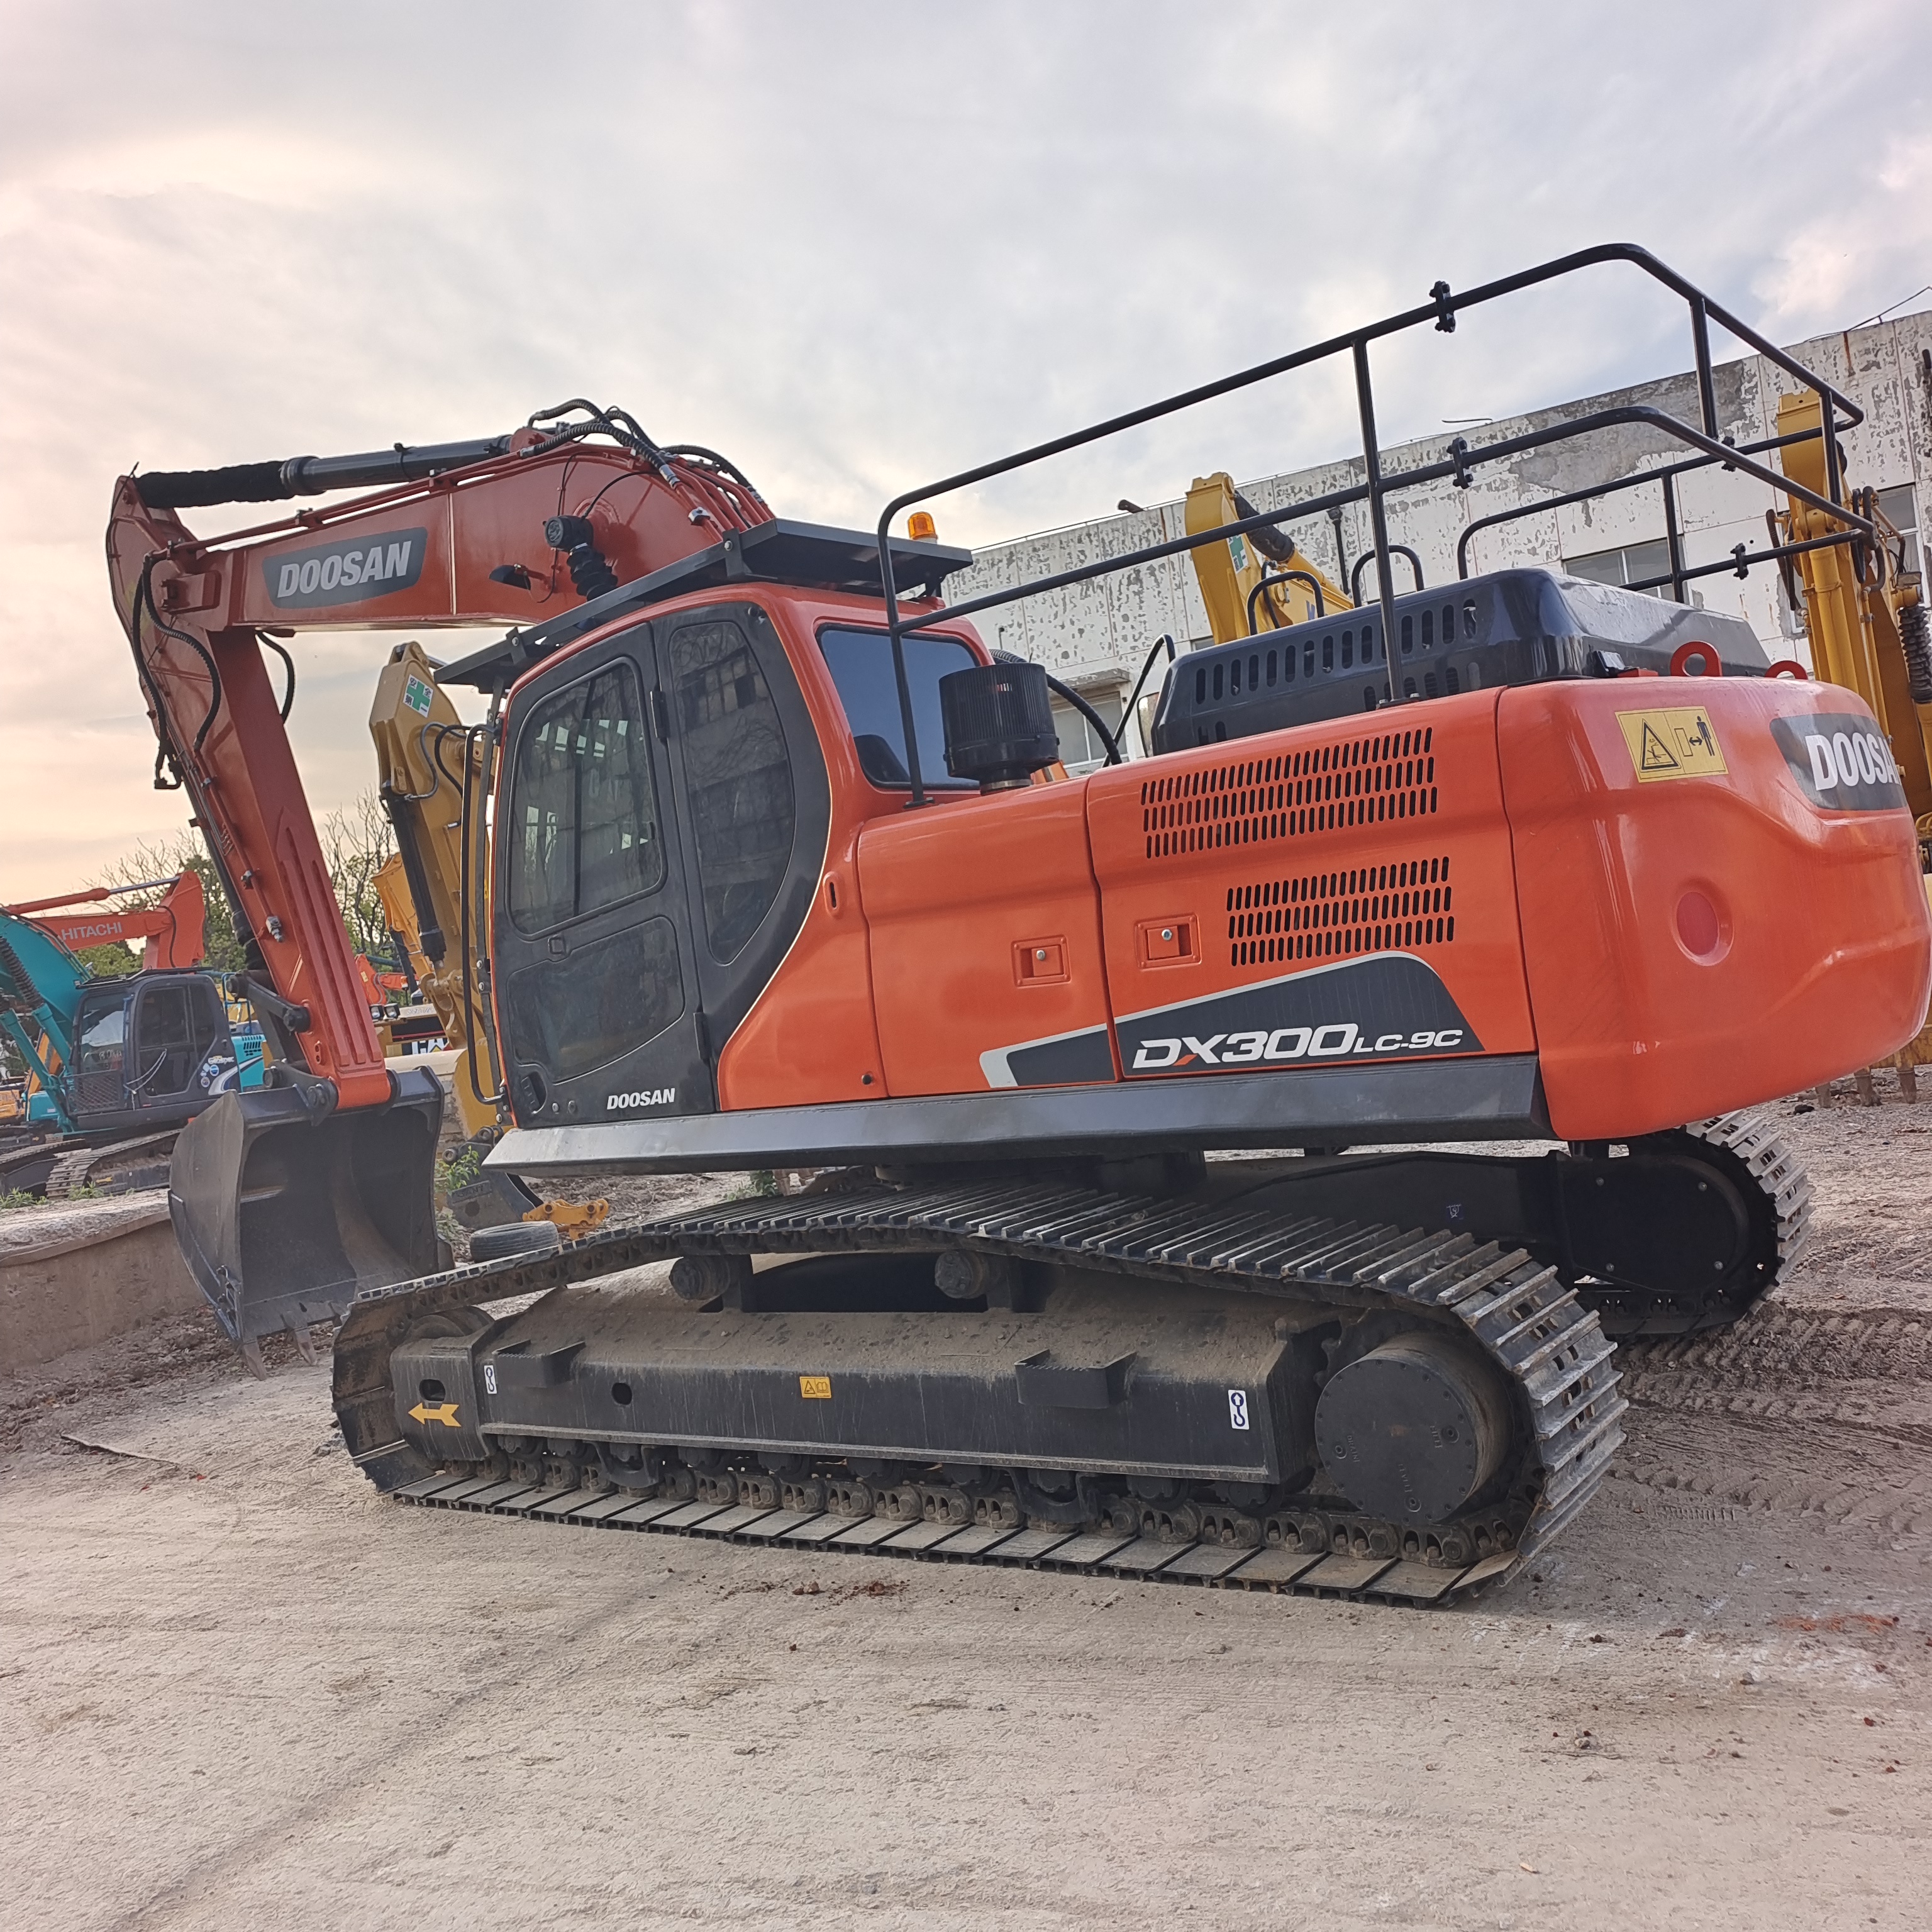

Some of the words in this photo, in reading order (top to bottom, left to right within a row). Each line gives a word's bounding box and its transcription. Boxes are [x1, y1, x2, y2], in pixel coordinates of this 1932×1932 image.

[277, 540, 412, 598] DOOSAN
[1805, 732, 1901, 791] DOOSA
[61, 921, 123, 940] HITACHI
[606, 1087, 675, 1110] DOOSAN
[1347, 1435, 1360, 1462] DRAIN
